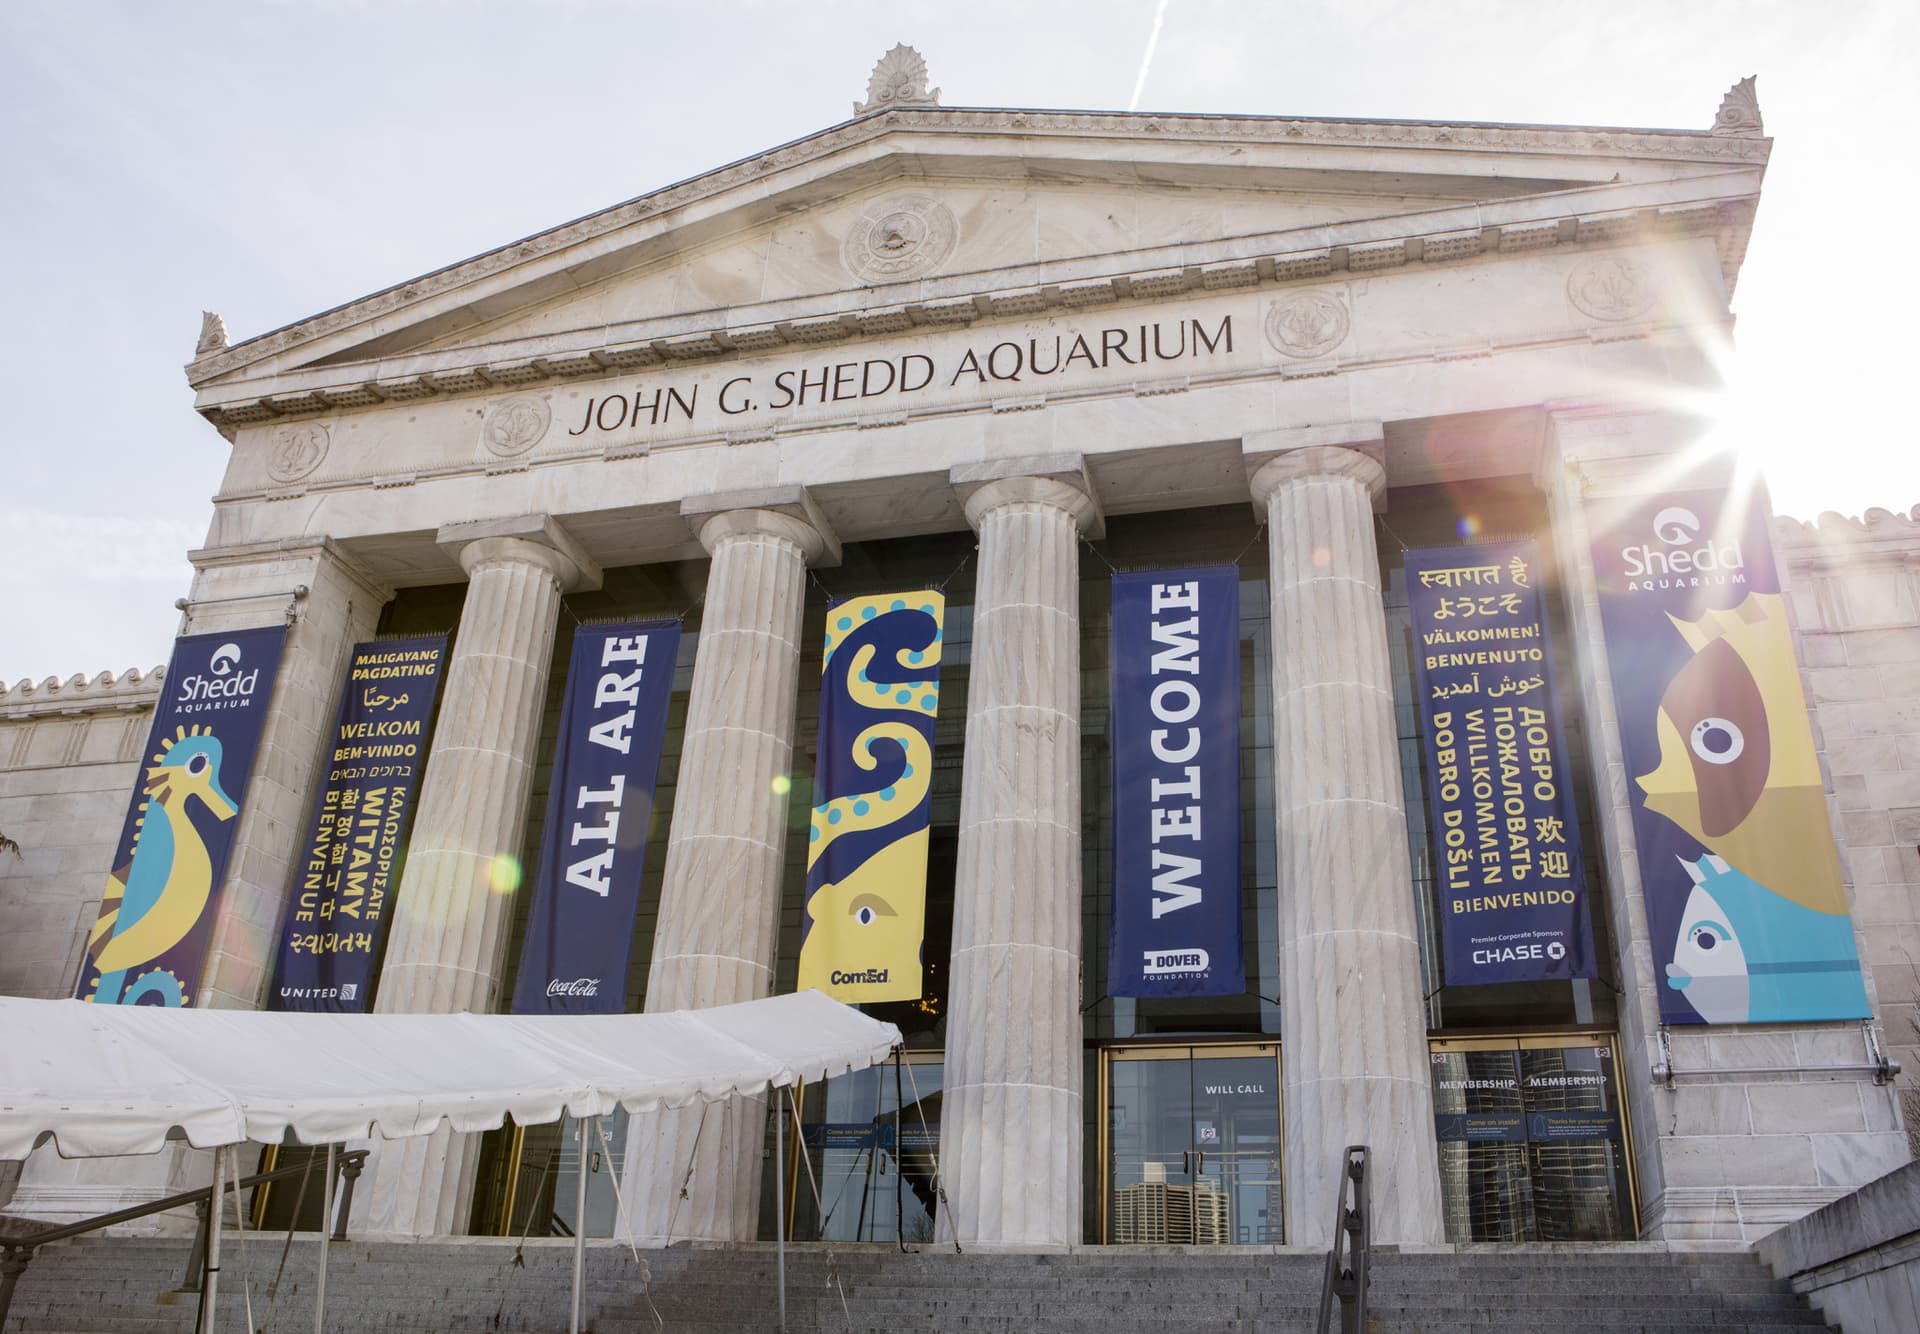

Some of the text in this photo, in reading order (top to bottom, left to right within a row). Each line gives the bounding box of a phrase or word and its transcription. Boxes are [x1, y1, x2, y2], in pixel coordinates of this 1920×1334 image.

[569, 314, 1234, 436] JOHN G. SHEDD AQUARIUM
[1622, 540, 1745, 577] Shedd
[1418, 565, 1500, 589] स्वागत
[1628, 574, 1746, 591] AQUARIUM
[1433, 592, 1523, 620] ようこそ
[1424, 623, 1541, 646] VÄLKOMMEN!
[356, 649, 439, 666] MALIGAYANG
[1425, 648, 1543, 670] BENVENUTO
[352, 663, 435, 681] PAGDATING
[178, 668, 259, 702] Shedd
[1487, 673, 1545, 698] خوش
[175, 698, 250, 714] AQUARIUM
[340, 720, 421, 740] WELKOM
[333, 744, 417, 762] BEM-VINDO
[1150, 581, 1203, 919] WELCOME
[1518, 706, 1556, 802] ДОБРО
[329, 765, 412, 781] ברוכים הבאים
[565, 634, 649, 897] ALL ARE
[1433, 711, 1474, 889] DOBRO DOŠLI
[1465, 708, 1503, 885] WILLKOMMEN
[1492, 706, 1532, 881] ПОЖАЛОВАТЬ
[296, 790, 340, 923] BIENVENUE
[320, 788, 360, 921] 환영합니다
[340, 787, 388, 920] WITAMY
[1533, 815, 1571, 879] 欢迎
[1453, 889, 1576, 914] BIENVENIDO
[1471, 930, 1564, 944] Premier Corporate Sponsors
[1156, 954, 1201, 968] DOVER
[1472, 944, 1544, 964] CHASE
[546, 978, 600, 997] Coca-Cola
[831, 968, 888, 985] ComEd
[1143, 973, 1209, 981] FOUNDATION
[280, 986, 338, 998] UNITED
[1205, 1085, 1264, 1094] WILL CALL
[1440, 1080, 1516, 1089] MEMBERSHIP
[1530, 1076, 1607, 1087] MEMBERSHIP
